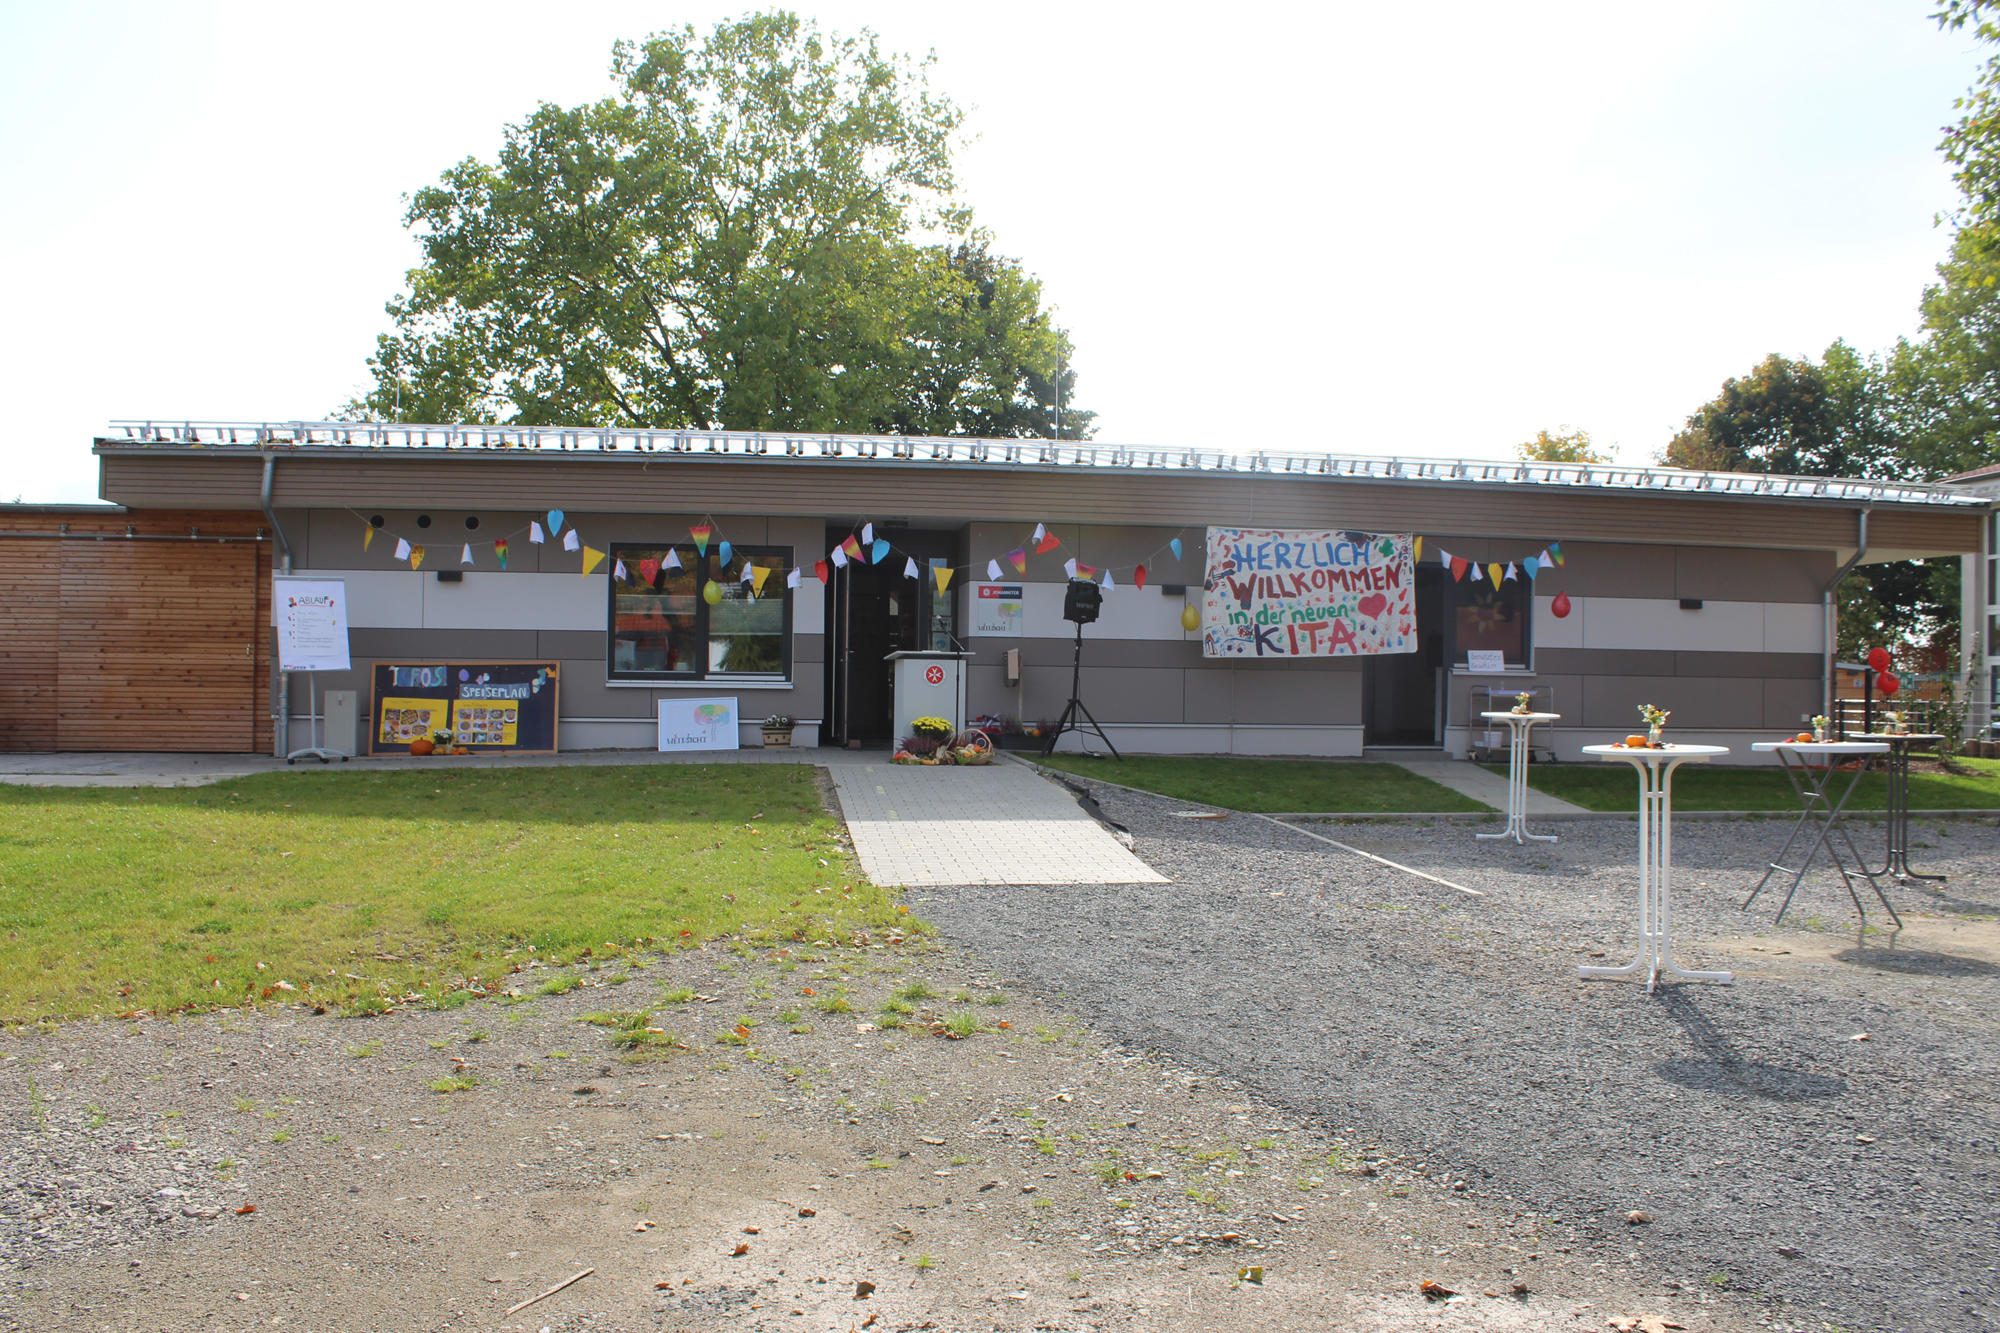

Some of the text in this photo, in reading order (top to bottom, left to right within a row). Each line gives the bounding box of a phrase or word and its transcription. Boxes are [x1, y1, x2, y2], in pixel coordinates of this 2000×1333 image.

[1231, 542, 1370, 572] HERZLICH
[1226, 562, 1402, 600] WILLKOMMEN
[298, 596, 326, 605] ABLAUF
[1226, 603, 1349, 625] in der neuen
[1254, 618, 1357, 656] KITA
[389, 666, 444, 687] INFOS
[461, 686, 527, 699] SPEISEPLAN
